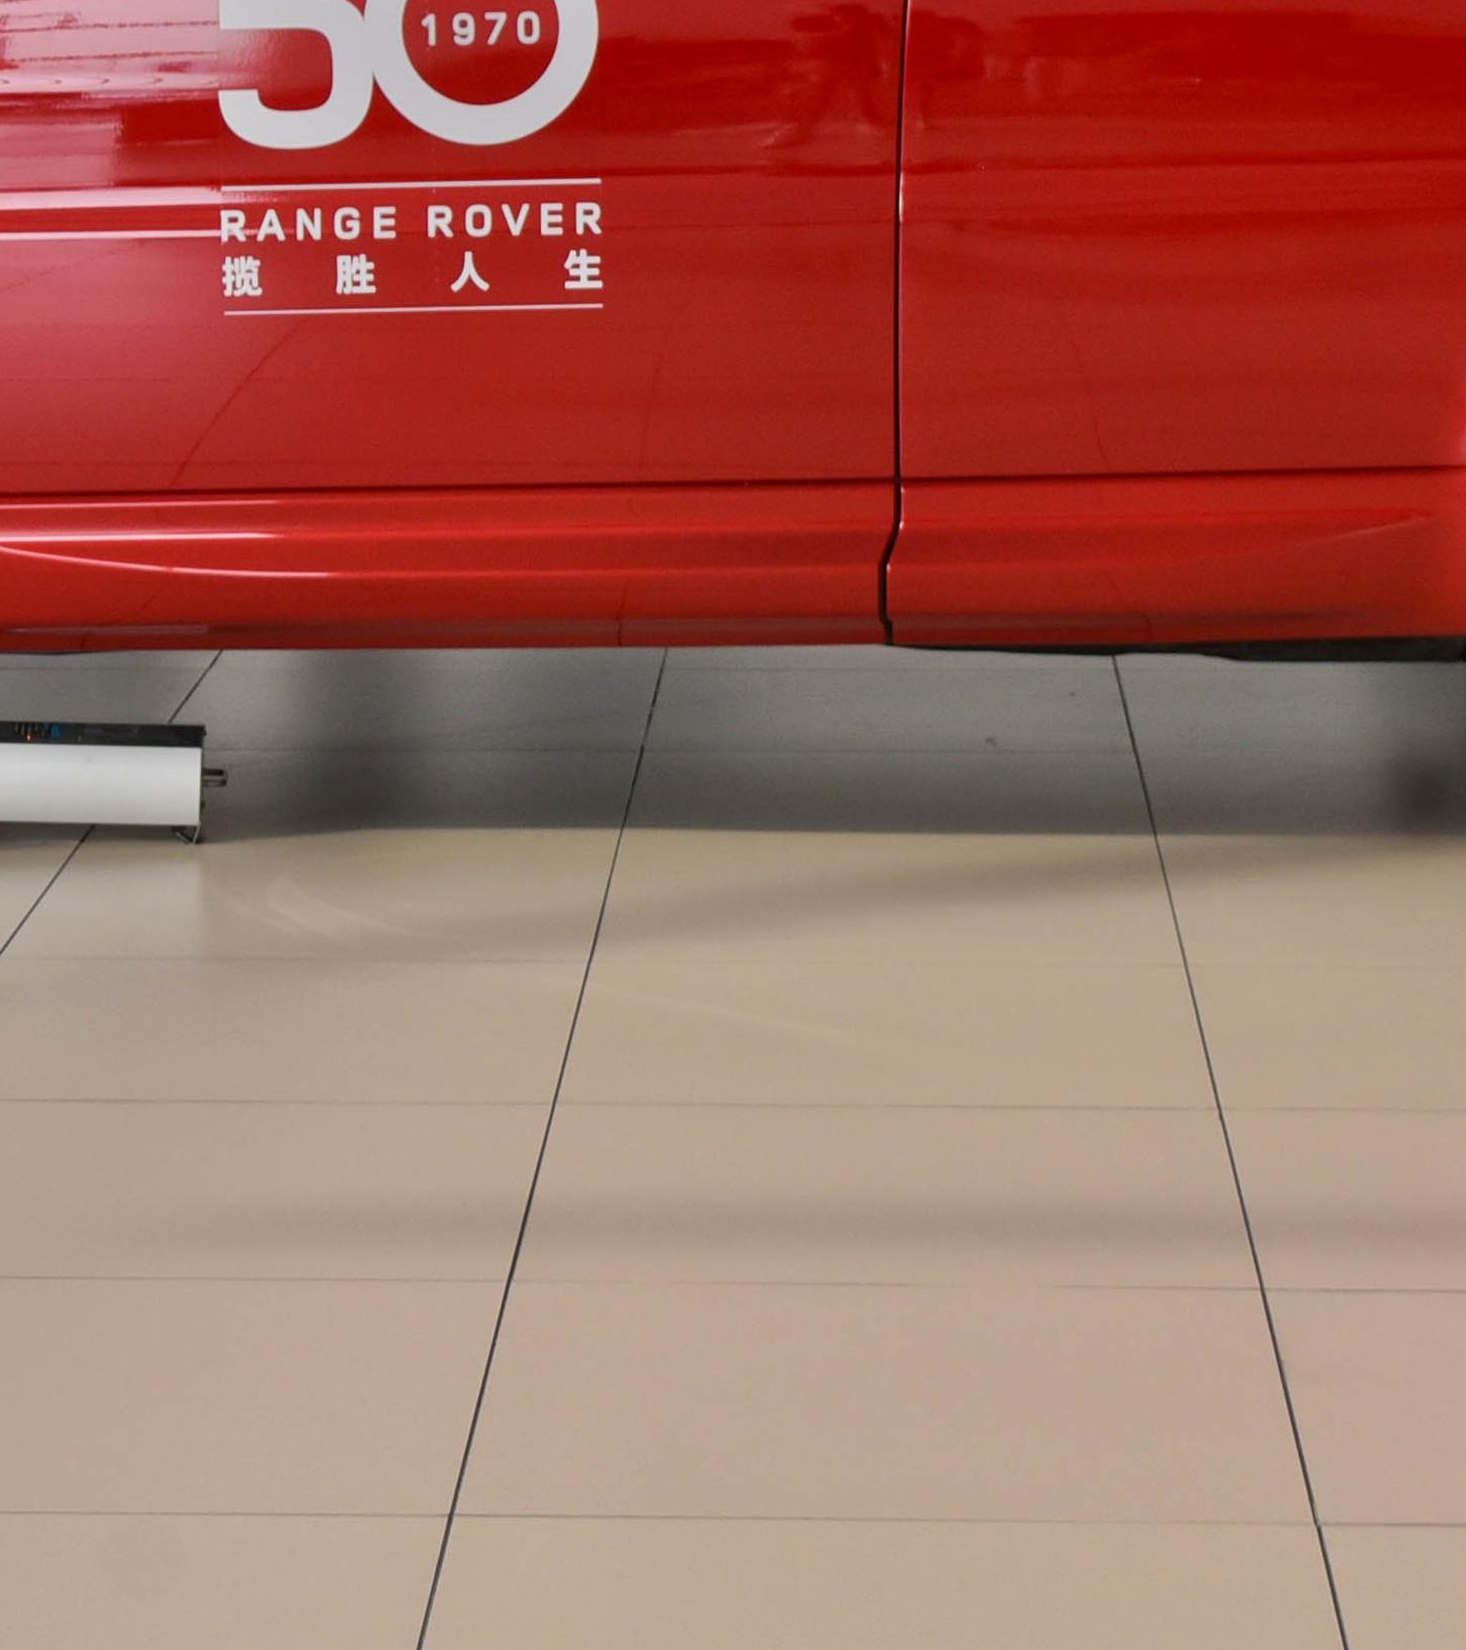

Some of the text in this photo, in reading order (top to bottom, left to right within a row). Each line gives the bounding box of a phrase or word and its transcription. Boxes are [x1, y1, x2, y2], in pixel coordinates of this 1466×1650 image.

[421, 11, 541, 47] 1970
[220, 201, 603, 243] RANGE ROVER
[221, 248, 604, 297] 揽胜人生
